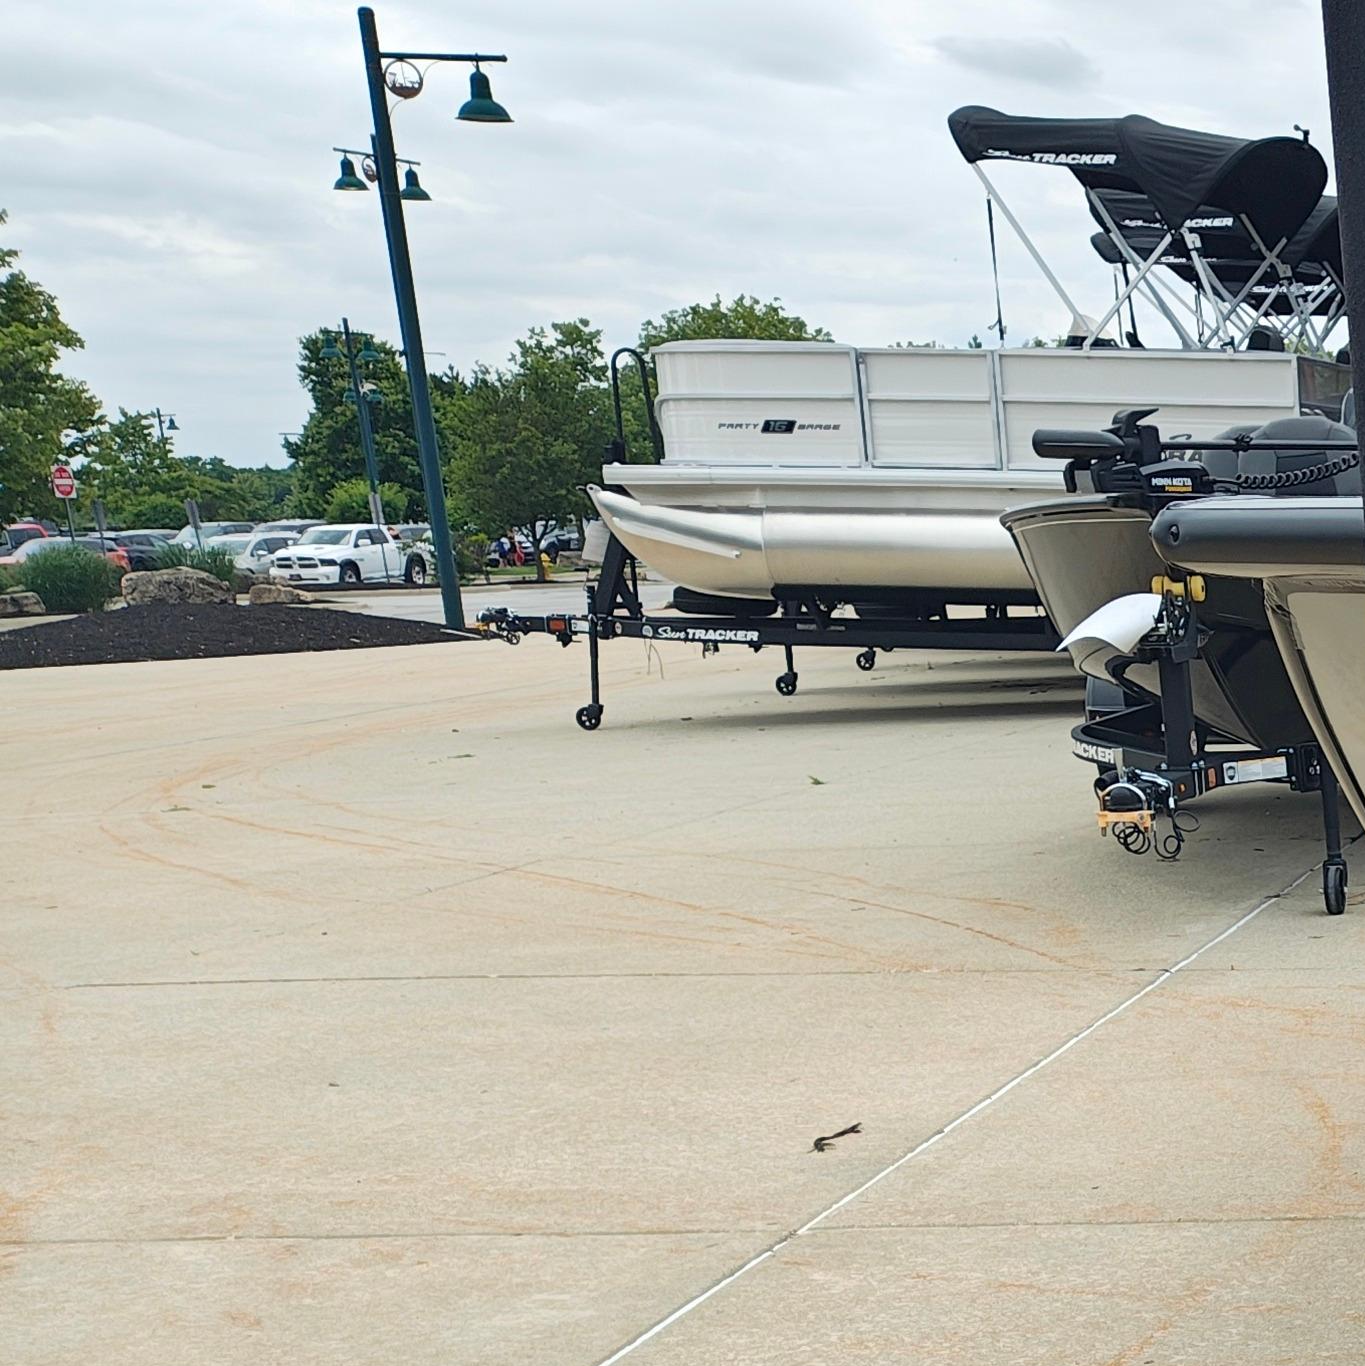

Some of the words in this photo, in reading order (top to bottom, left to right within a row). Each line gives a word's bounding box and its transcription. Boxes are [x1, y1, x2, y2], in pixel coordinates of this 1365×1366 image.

[1032, 153, 1117, 165] TRACKER
[769, 421, 788, 431] 16
[687, 629, 759, 641] TRACKER
